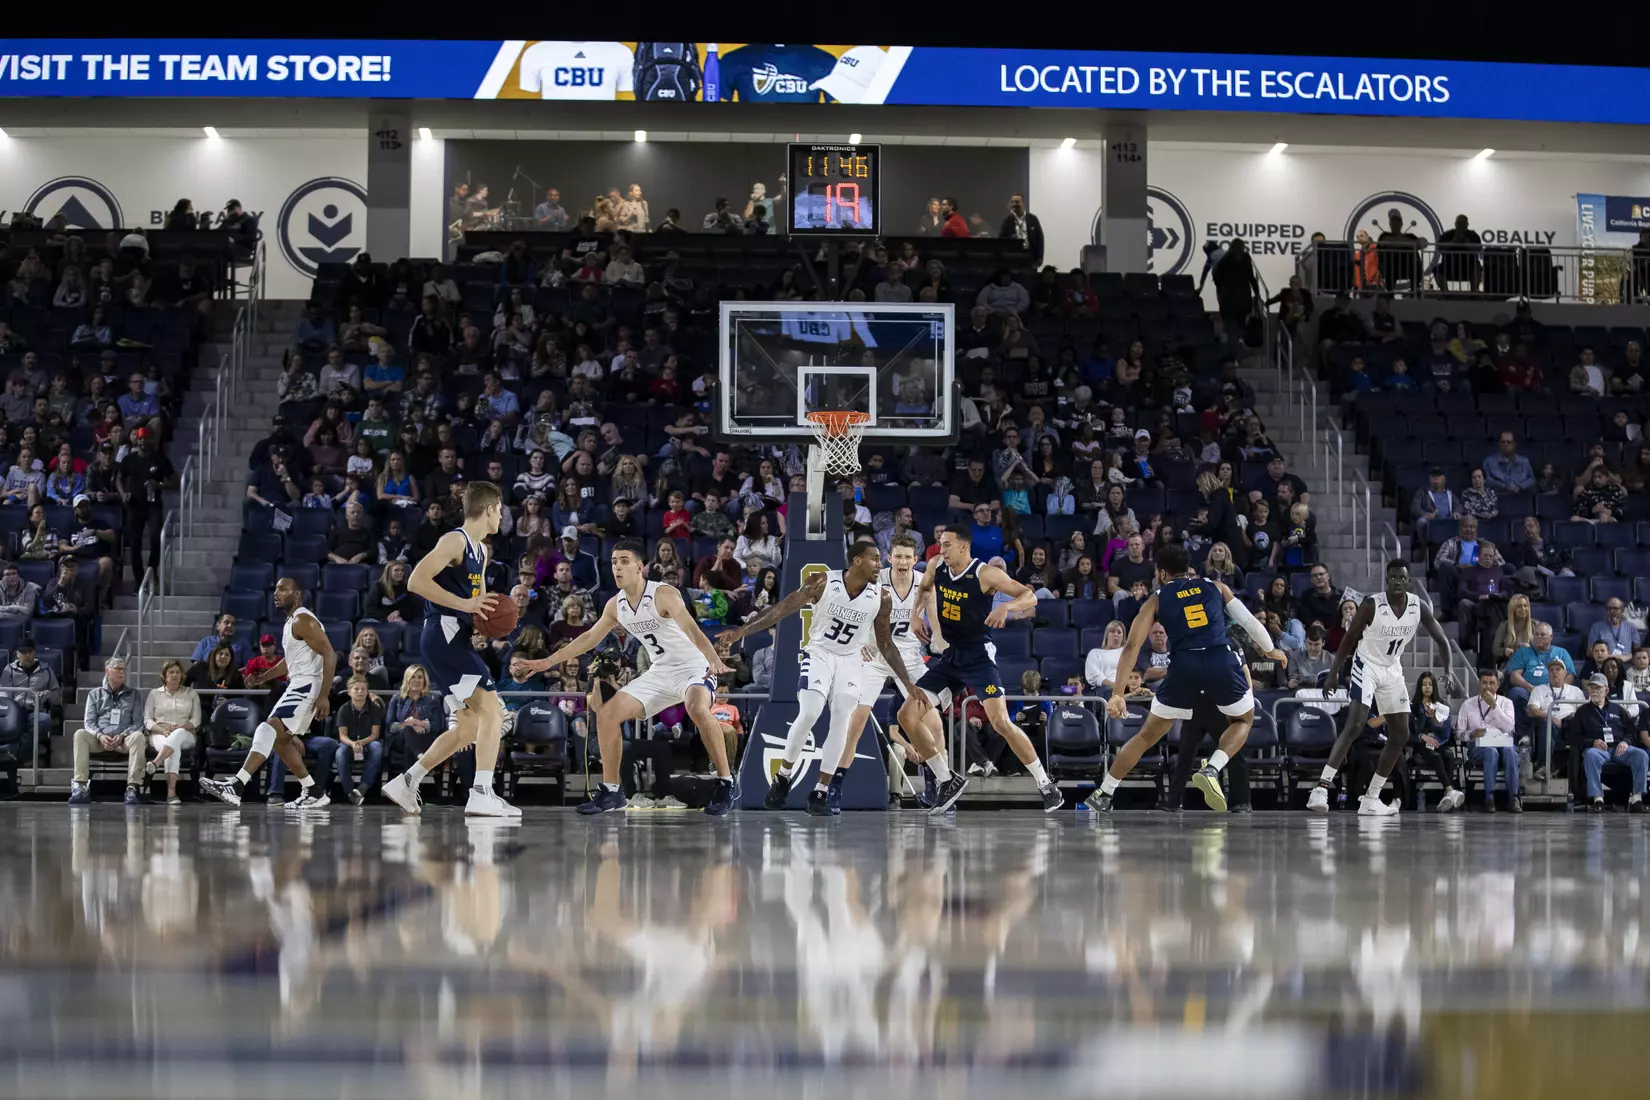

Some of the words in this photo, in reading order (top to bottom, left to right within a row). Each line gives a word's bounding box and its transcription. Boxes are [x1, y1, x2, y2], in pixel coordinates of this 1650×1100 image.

[81, 54, 150, 81] THE
[159, 54, 258, 81] TEAM
[266, 54, 392, 82] STORE!
[840, 56, 860, 68] CBU
[554, 66, 604, 87] CBU
[1000, 64, 1140, 94] LOCATED
[1149, 67, 1187, 96] BY
[1190, 68, 1251, 97] THE
[1260, 70, 1450, 103] ESCALATORS
[658, 89, 676, 98] CBU
[775, 80, 808, 93] CBU
[1116, 142, 1137, 152] 113
[825, 182, 860, 223] 19
[1206, 223, 1305, 239] EQUIPPED
[1481, 229, 1556, 245] OBALLY
[1581, 270, 1595, 304] PURP
[939, 585, 969, 599] KANSAS
[943, 592, 961, 602] CITY
[827, 602, 868, 624] LANCERS
[941, 601, 961, 621] 25
[1183, 603, 1209, 629] 5
[823, 617, 860, 645] 35
[890, 621, 910, 638] 12
[643, 633, 665, 656] 3
[1386, 638, 1404, 656] 11
